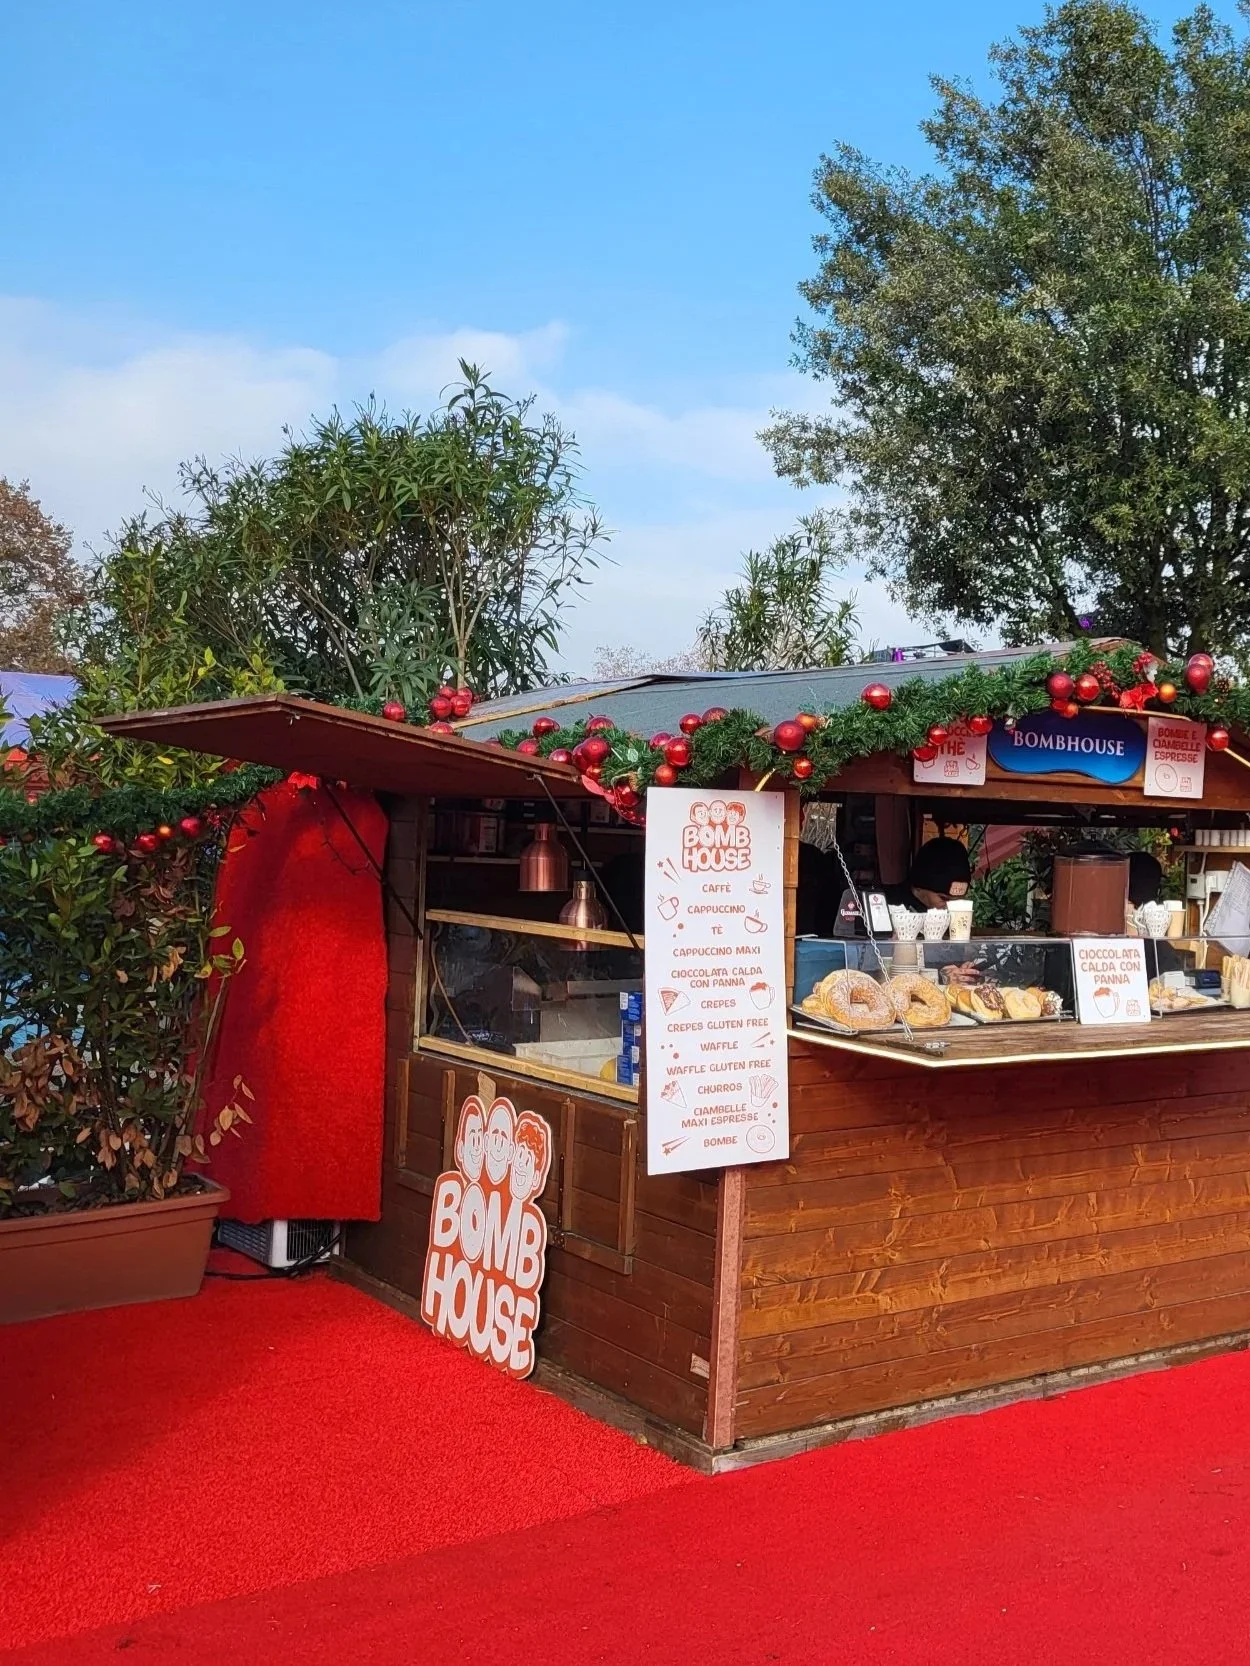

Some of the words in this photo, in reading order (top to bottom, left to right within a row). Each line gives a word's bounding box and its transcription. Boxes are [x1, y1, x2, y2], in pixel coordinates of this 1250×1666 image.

[1013, 731, 1125, 756] BOMBHOUSE
[1153, 739, 1201, 752] CIAMBELLE
[1155, 751, 1198, 763] ESPRESSE
[683, 825, 751, 848] BOMB
[683, 847, 751, 872] HOUSE
[702, 882, 731, 893] CAFFÈ
[687, 904, 746, 914] CAPPUCCINO
[711, 924, 723, 935] TÈ
[673, 947, 732, 957] CAPPUCCINO
[735, 946, 761, 955] MAXI
[1078, 949, 1141, 960] CIOCCOLATA
[1081, 961, 1116, 972] CALDA
[1119, 961, 1141, 972] CON
[671, 968, 728, 978] CIOCCOLATA
[732, 967, 763, 976] CALDA
[690, 980, 710, 988] CON
[713, 978, 745, 987] PANNA
[1094, 974, 1131, 985] PANNA
[701, 999, 736, 1009] CREPES
[667, 1022, 703, 1032] CREPES
[707, 1020, 743, 1030] GLUTEN
[746, 1018, 769, 1027] FREE
[700, 1041, 739, 1051] WAFFLE
[666, 1065, 706, 1075] WAFFLE
[709, 1061, 746, 1072] GLUTEN
[748, 1059, 771, 1069] FREE
[697, 1083, 743, 1094] CHURROS
[694, 1103, 747, 1116] CIAMBELLE
[681, 1118, 708, 1128] MAXI
[711, 1113, 759, 1126] ESPRESSE
[703, 1136, 738, 1147] BOMBE
[433, 1180, 542, 1290] BOMB
[425, 1251, 536, 1370] HOUSE
